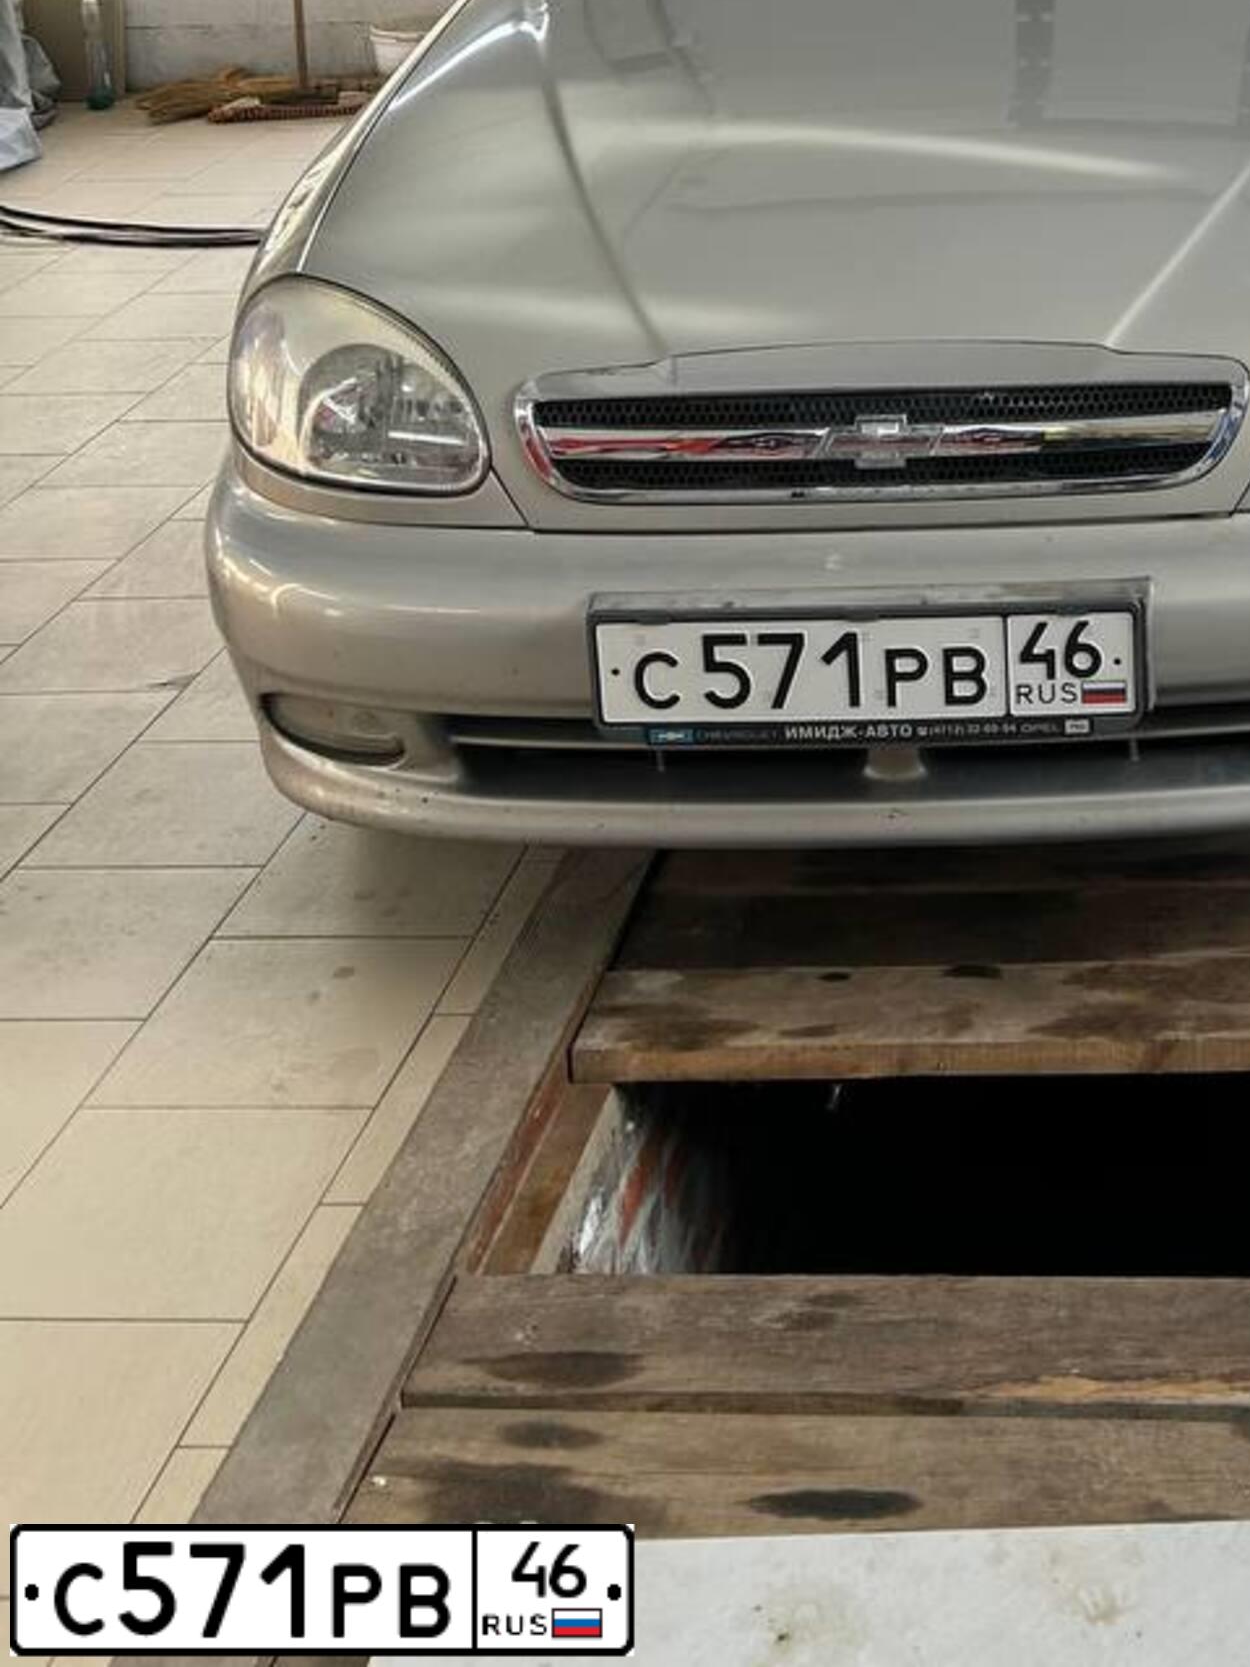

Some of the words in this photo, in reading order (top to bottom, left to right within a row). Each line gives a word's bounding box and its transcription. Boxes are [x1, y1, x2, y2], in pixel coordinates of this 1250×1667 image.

[634, 631, 987, 710] С571РВ
[1019, 620, 1102, 681] 46
[1016, 683, 1078, 705] RUS
